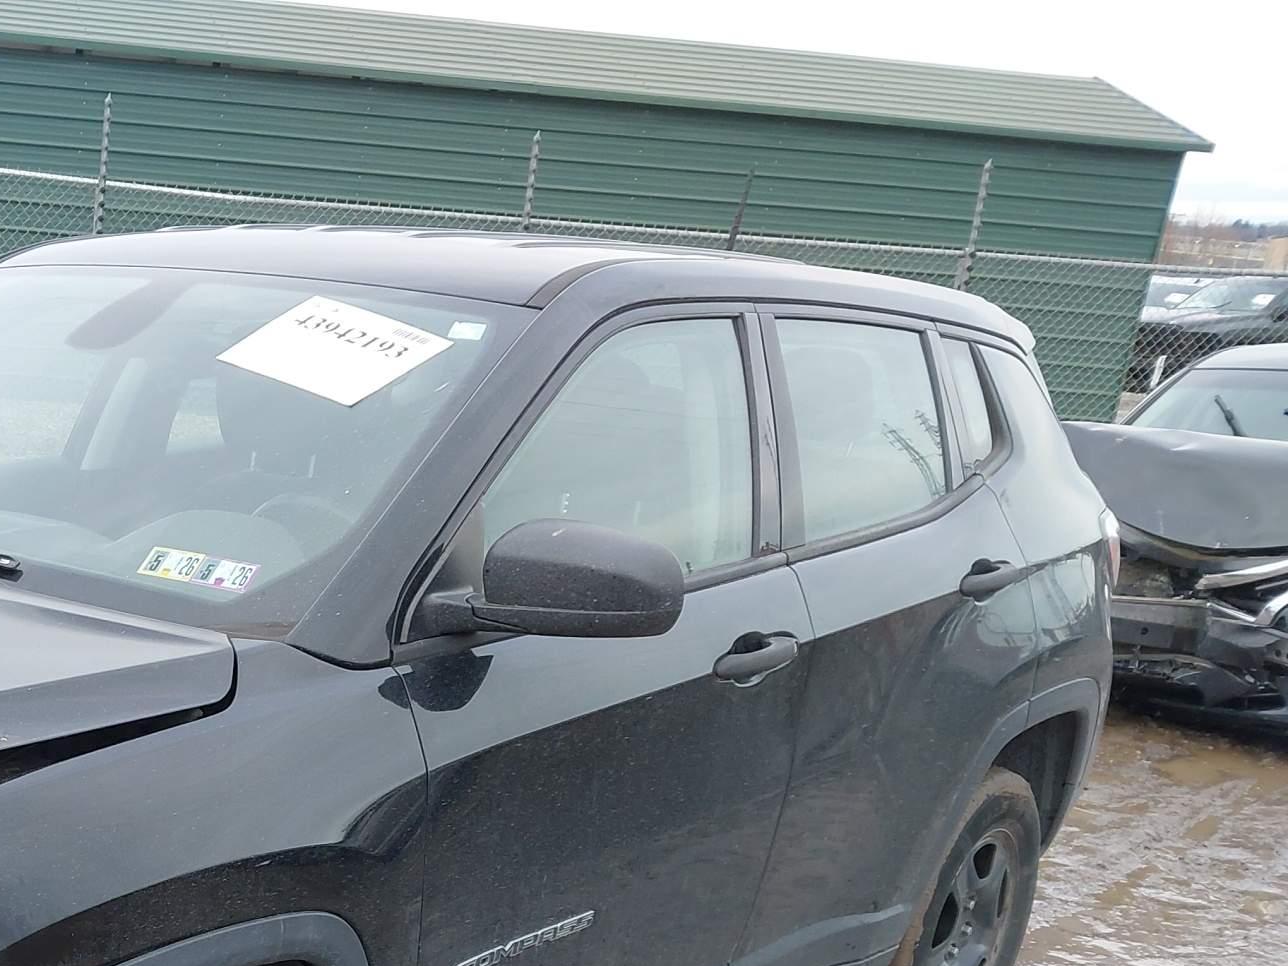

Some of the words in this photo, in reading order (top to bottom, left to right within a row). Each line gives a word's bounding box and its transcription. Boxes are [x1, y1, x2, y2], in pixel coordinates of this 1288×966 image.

[295, 315, 409, 358] 43942193
[178, 556, 200, 576] 26
[231, 566, 253, 586] 26
